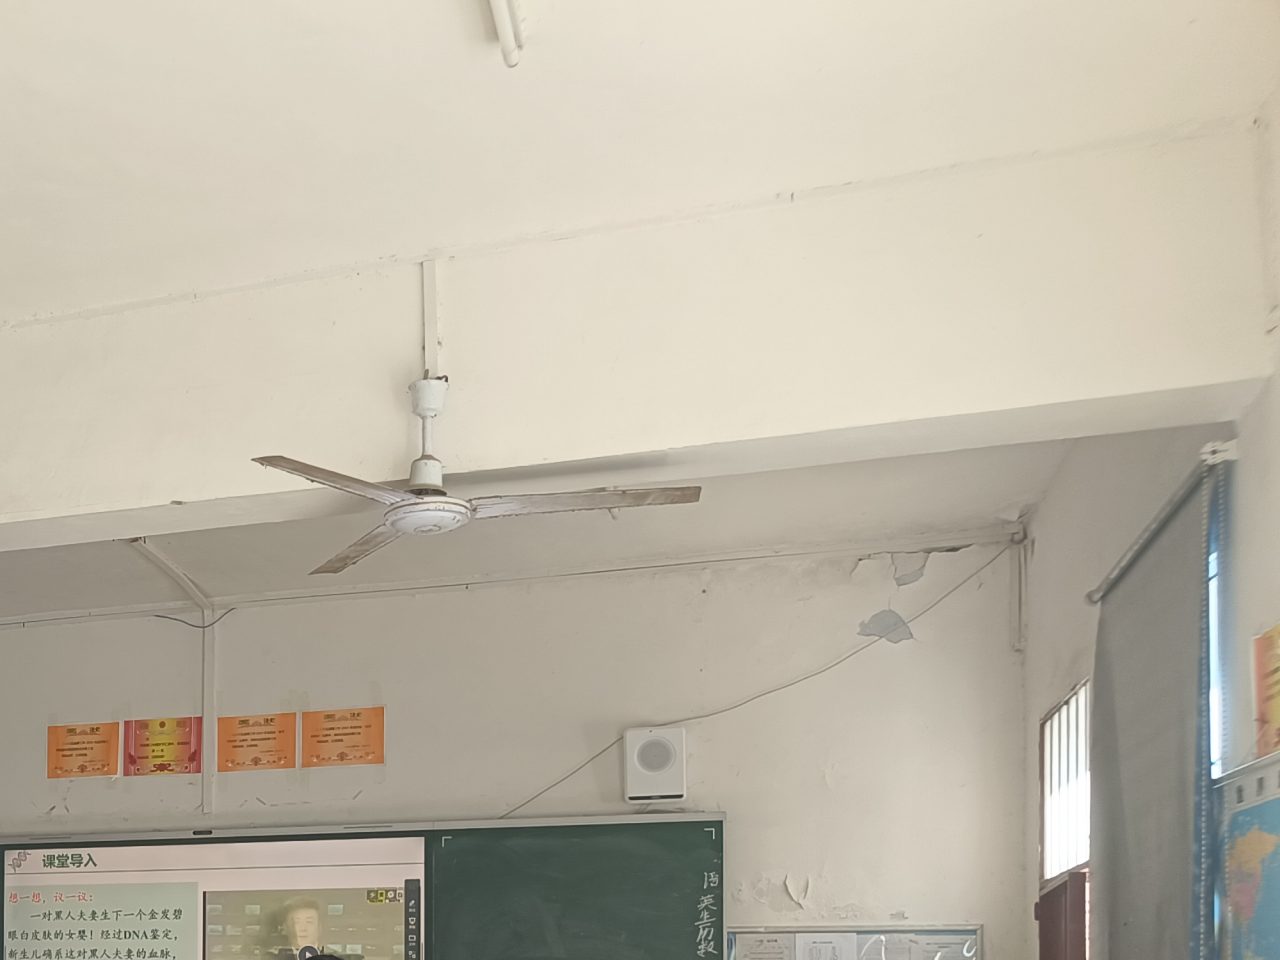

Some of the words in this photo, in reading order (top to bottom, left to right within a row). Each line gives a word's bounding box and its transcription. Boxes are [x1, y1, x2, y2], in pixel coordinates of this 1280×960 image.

[41, 852, 98, 869] 课堂导入
[30, 907, 183, 922] 一对黑人夫妻生下一个金发碧
